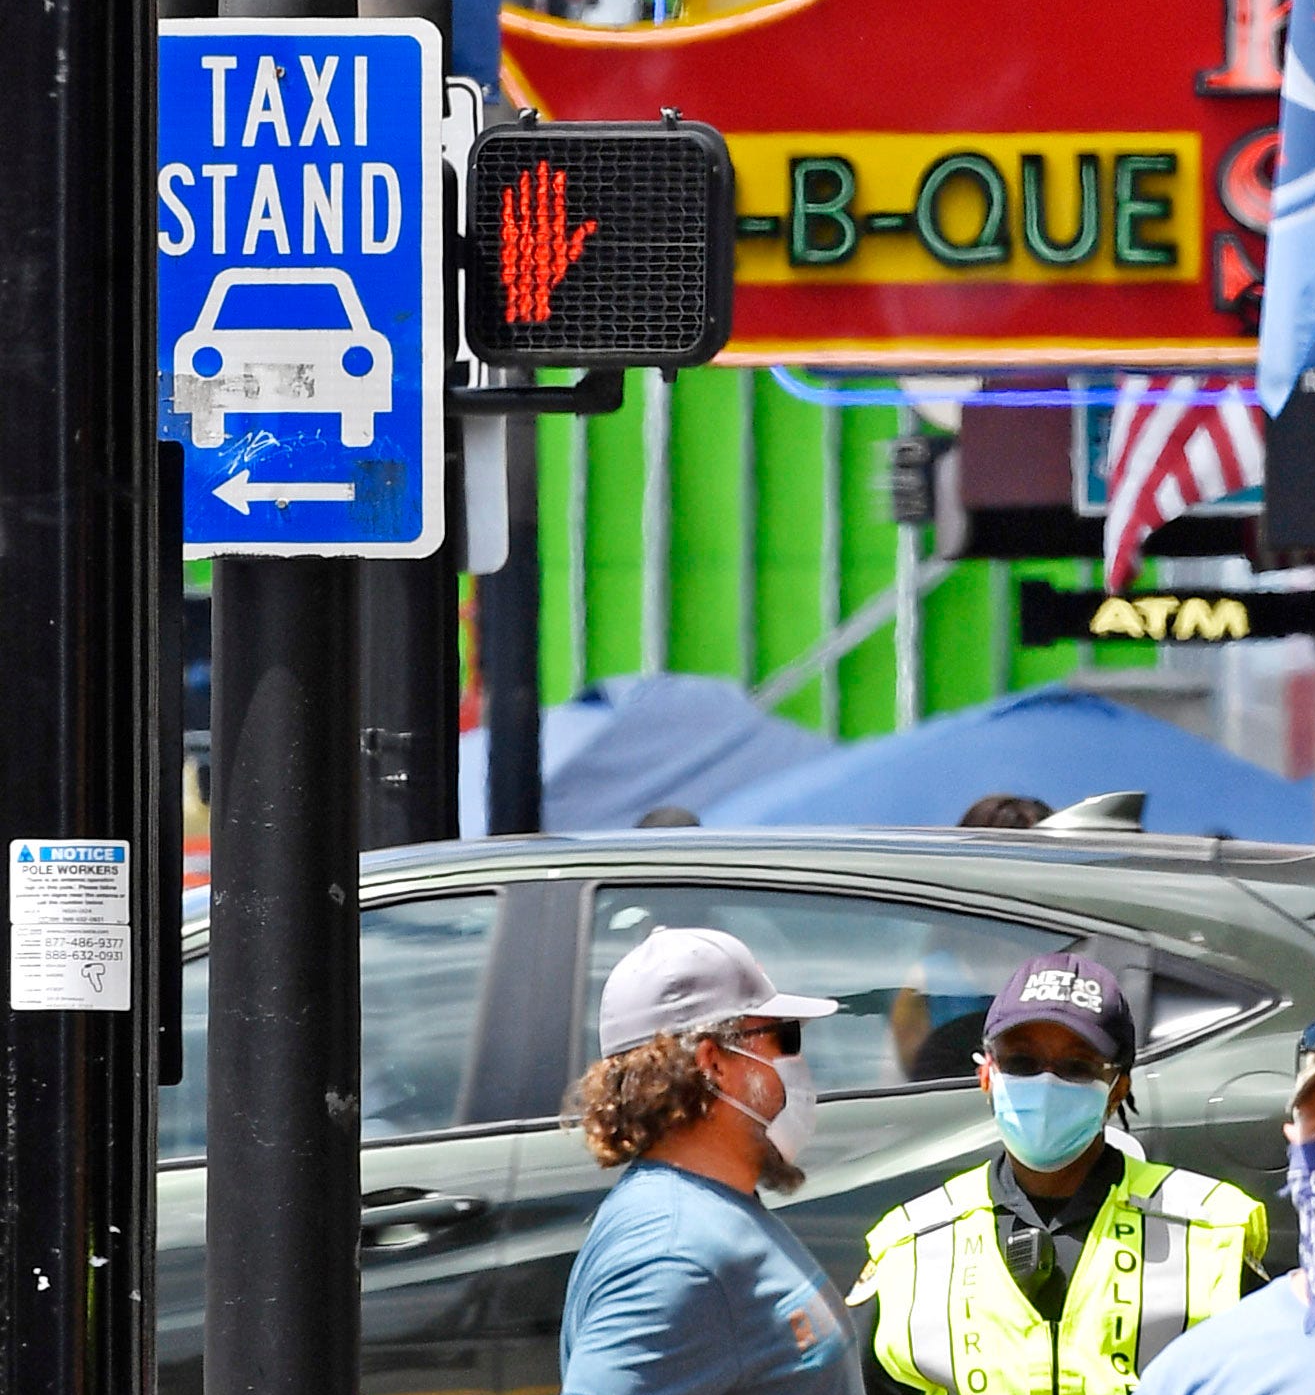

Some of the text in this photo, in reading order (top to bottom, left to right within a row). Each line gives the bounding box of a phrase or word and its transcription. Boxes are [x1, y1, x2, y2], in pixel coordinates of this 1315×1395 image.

[201, 55, 367, 147] TAXI
[158, 162, 402, 256] STAND
[1090, 596, 1250, 641] ATM
[22, 865, 119, 875] POLE WORKERS
[51, 848, 114, 862] NOTICE
[1024, 970, 1101, 996] METRO
[961, 1235, 988, 1394] METRO
